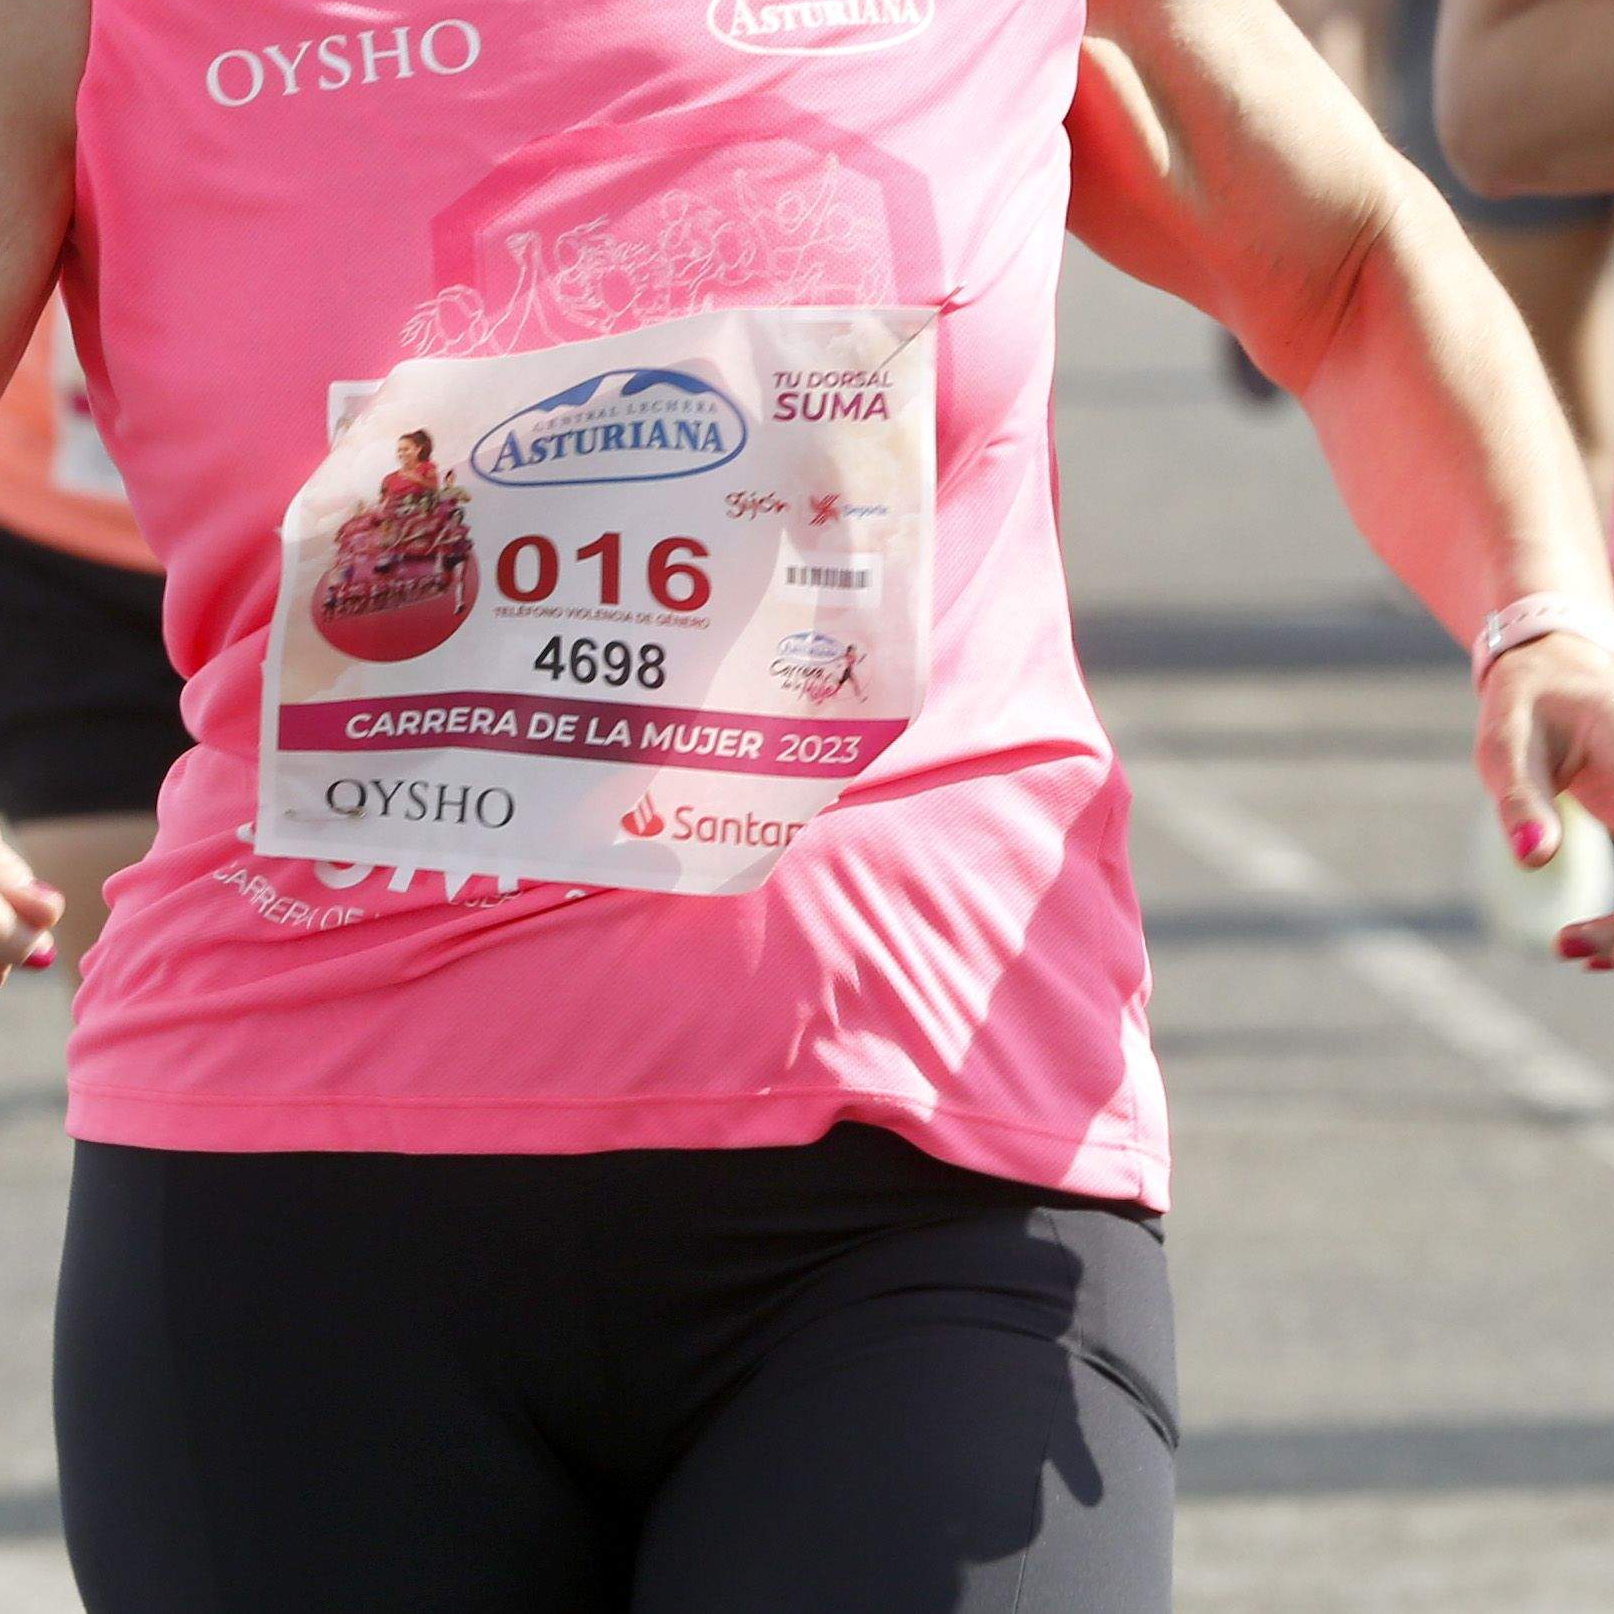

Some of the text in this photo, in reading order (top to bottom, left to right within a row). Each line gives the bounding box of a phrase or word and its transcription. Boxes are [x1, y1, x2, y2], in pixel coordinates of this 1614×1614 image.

[205, 18, 482, 108] OYSHO
[772, 391, 891, 423] SUMA
[773, 370, 894, 389] TU DORSAL
[488, 417, 729, 474] ASTURIANA
[495, 532, 712, 612] 016
[534, 635, 666, 689] 4698
[344, 705, 861, 765] CARRERA DE LA MUJER 2023
[325, 777, 515, 830] OYSHO
